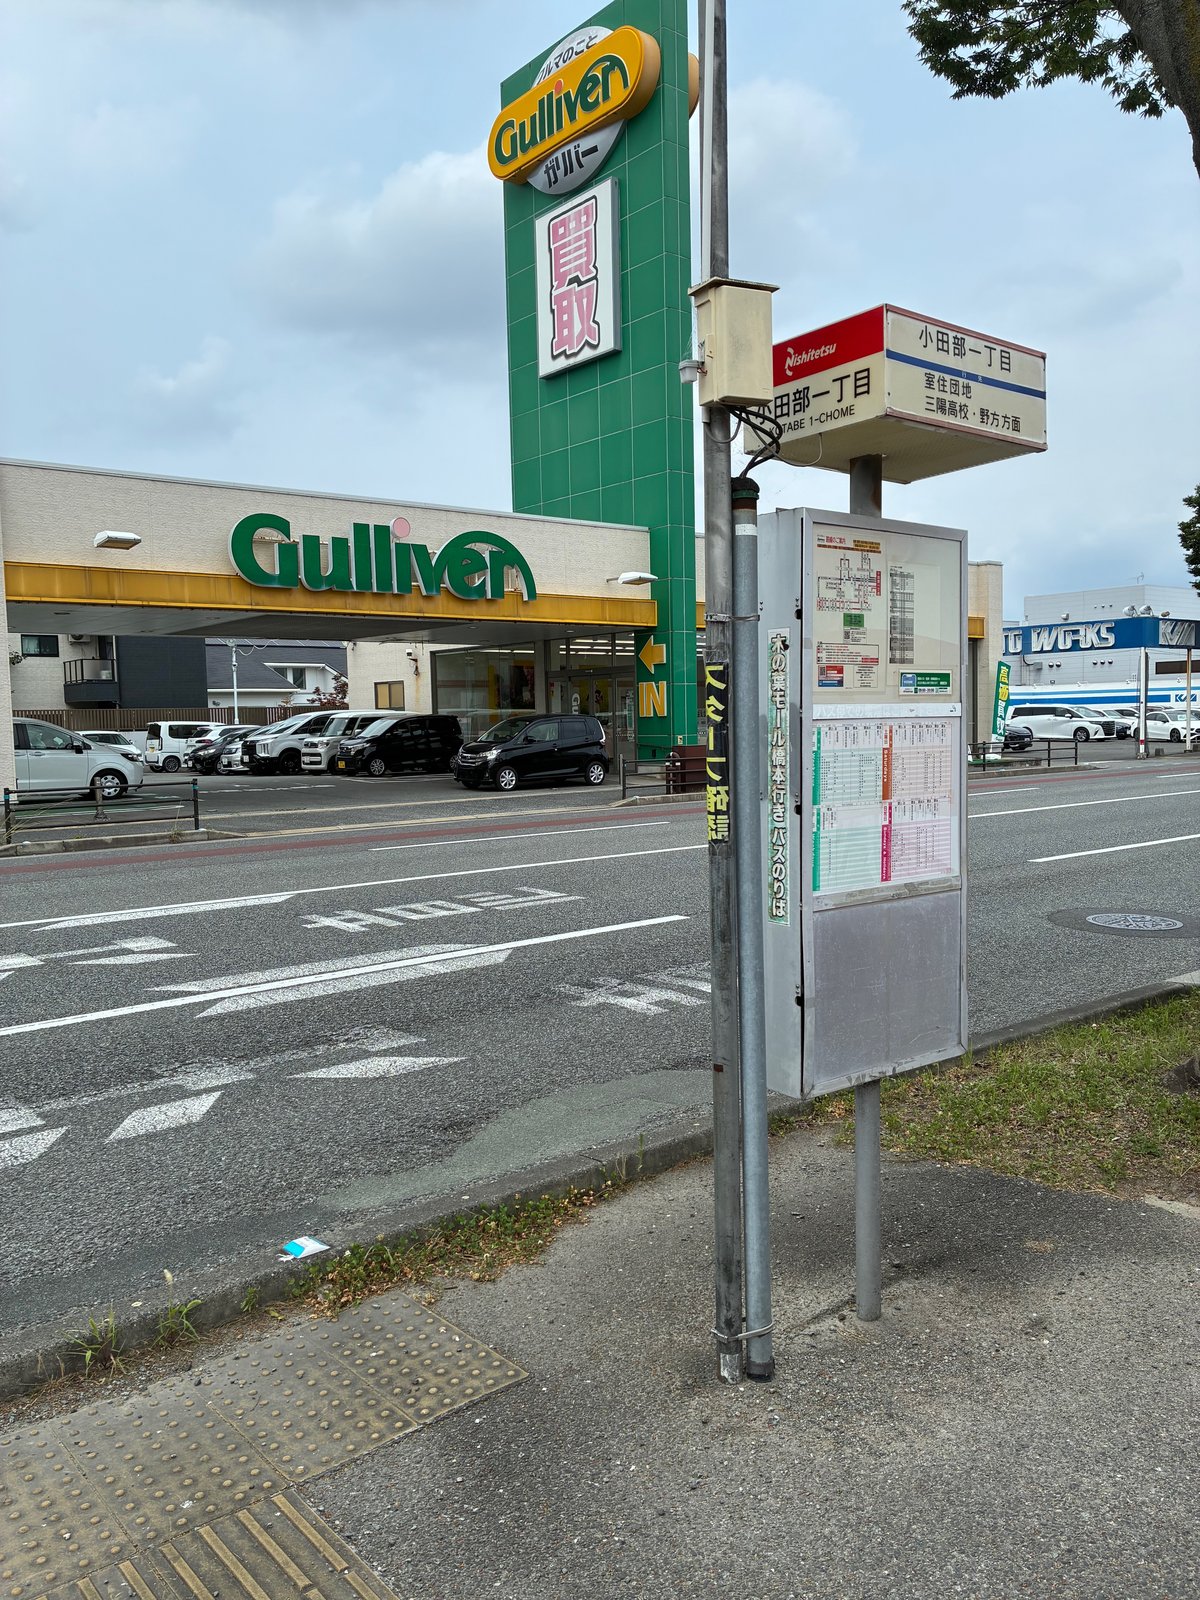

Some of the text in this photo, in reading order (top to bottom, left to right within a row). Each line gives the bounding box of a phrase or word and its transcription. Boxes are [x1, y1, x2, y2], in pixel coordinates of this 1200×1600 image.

[494, 53, 631, 166] Gulliver
[543, 143, 599, 190] ガリバー
[549, 196, 600, 358] 買取
[785, 346, 837, 377] Nishitetsu
[919, 325, 1011, 373] 小田部一丁目
[755, 367, 871, 426] 小田部一丁目
[924, 372, 972, 399] 室住団地
[809, 404, 856, 426] 1-CHOME
[229, 512, 538, 602] Gulliver
[1031, 621, 1116, 652] WORKS
[638, 680, 668, 718] IN
